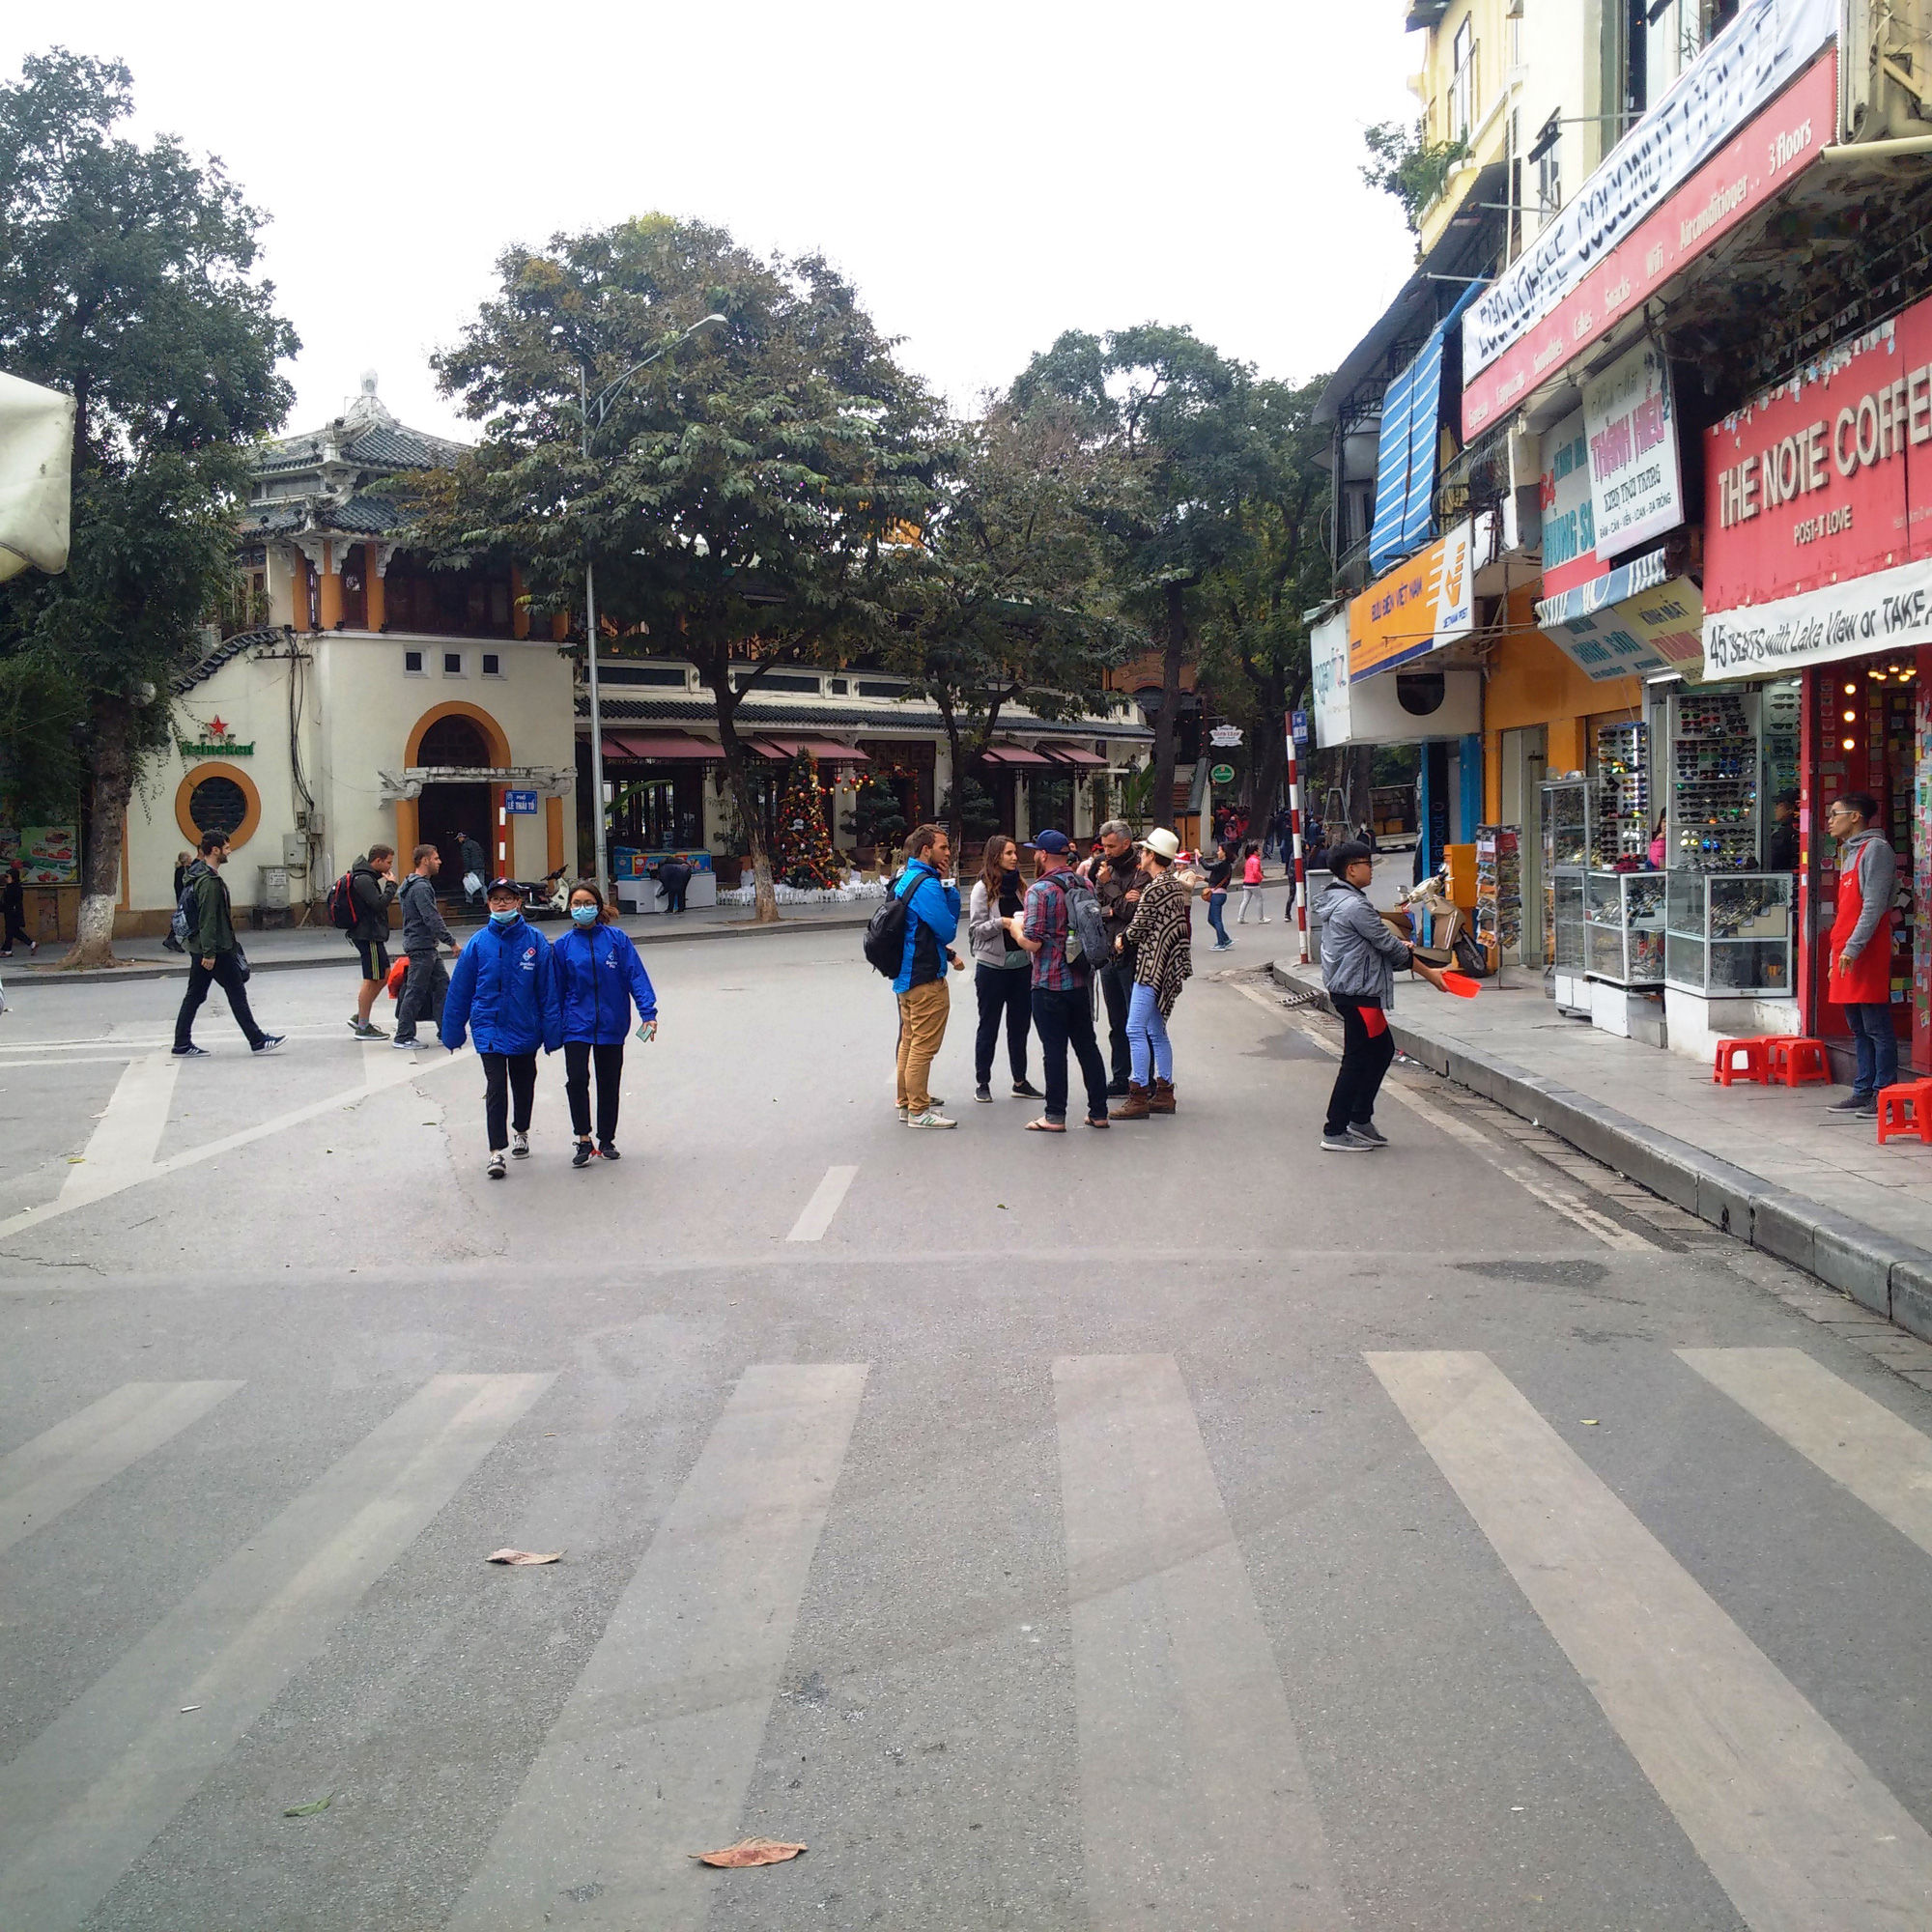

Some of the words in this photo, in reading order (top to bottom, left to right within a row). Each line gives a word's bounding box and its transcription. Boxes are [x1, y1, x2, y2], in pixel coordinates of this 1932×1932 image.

[1719, 455, 1759, 528] THE
[1763, 420, 1830, 510] NOTE
[1834, 361, 1932, 477] COFFE
[1827, 505, 1853, 535] LOVE
[1710, 625, 1726, 668] 45
[1728, 628, 1765, 664] SEATS
[1765, 623, 1790, 657] with
[1790, 616, 1824, 653] Lake
[1826, 610, 1858, 646] View
[1861, 609, 1877, 639] or
[1883, 589, 1925, 635] TAKE
[181, 740, 256, 755] Heineken
